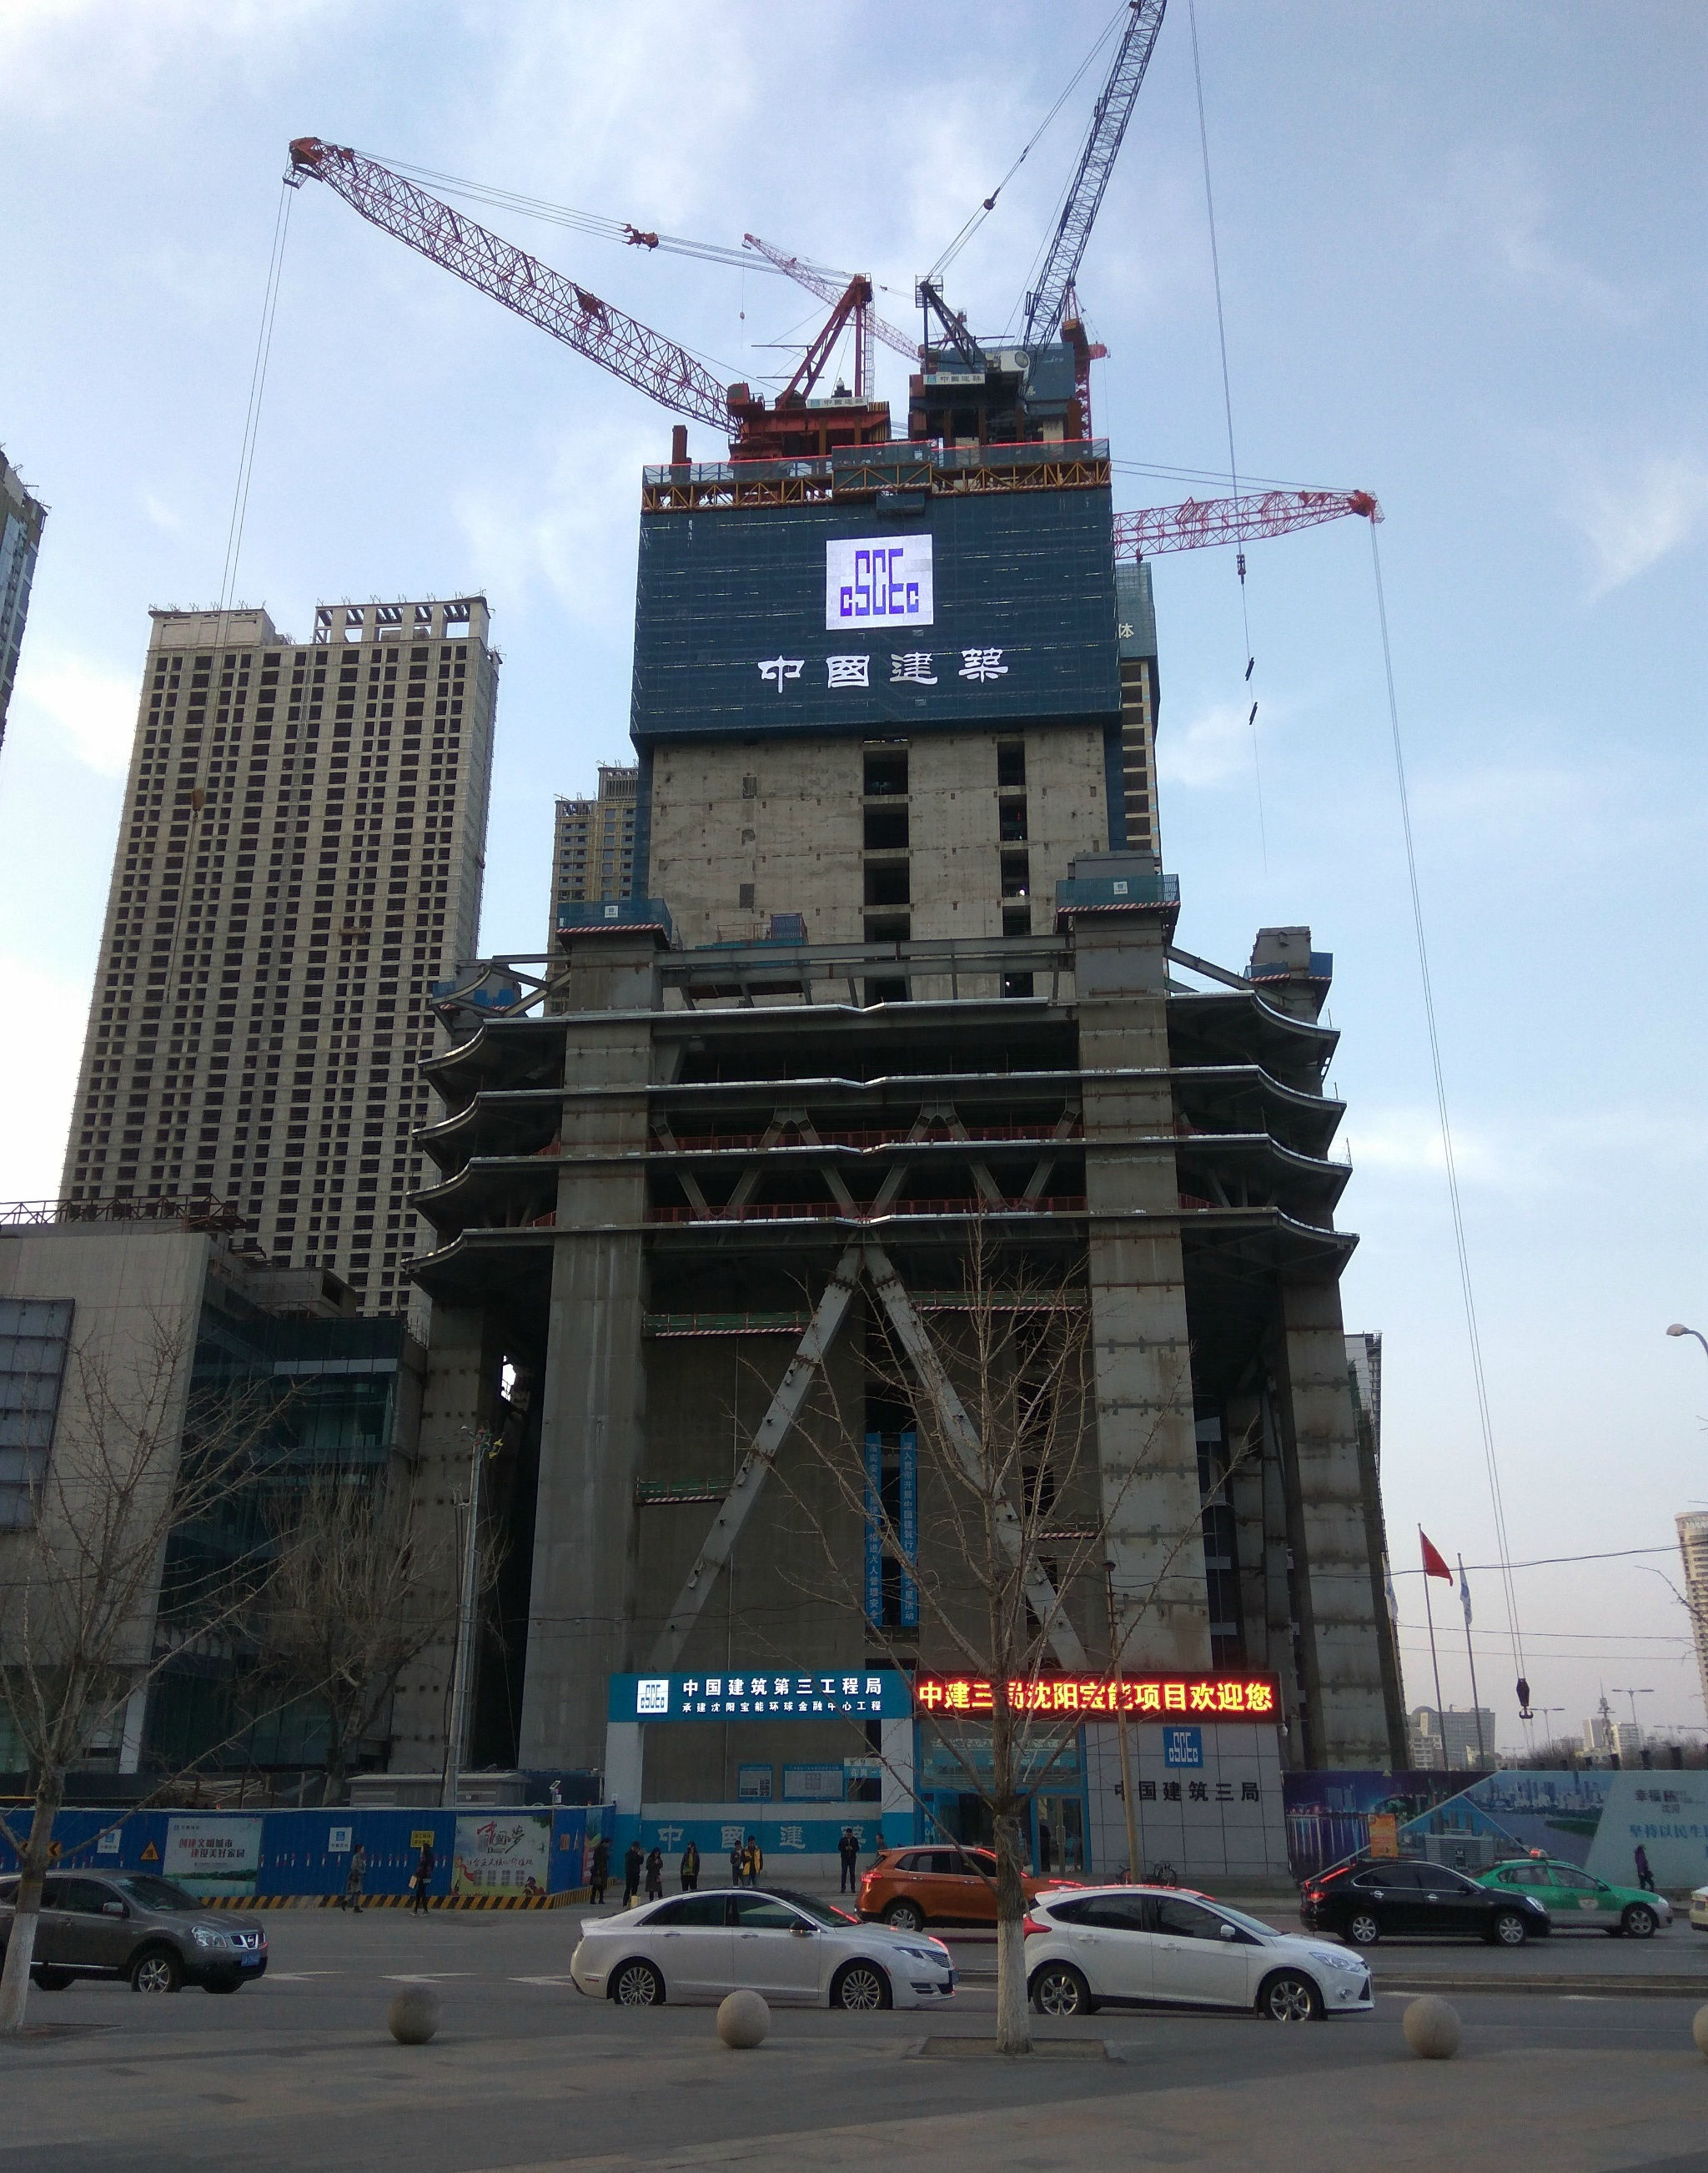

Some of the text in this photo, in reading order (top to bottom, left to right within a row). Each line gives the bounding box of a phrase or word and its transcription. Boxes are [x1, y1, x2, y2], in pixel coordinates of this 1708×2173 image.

[682, 1678, 882, 1697] 中国建筑第三工程局
[681, 1701, 882, 1713] 承建沈阳宝能环球金融中心工程
